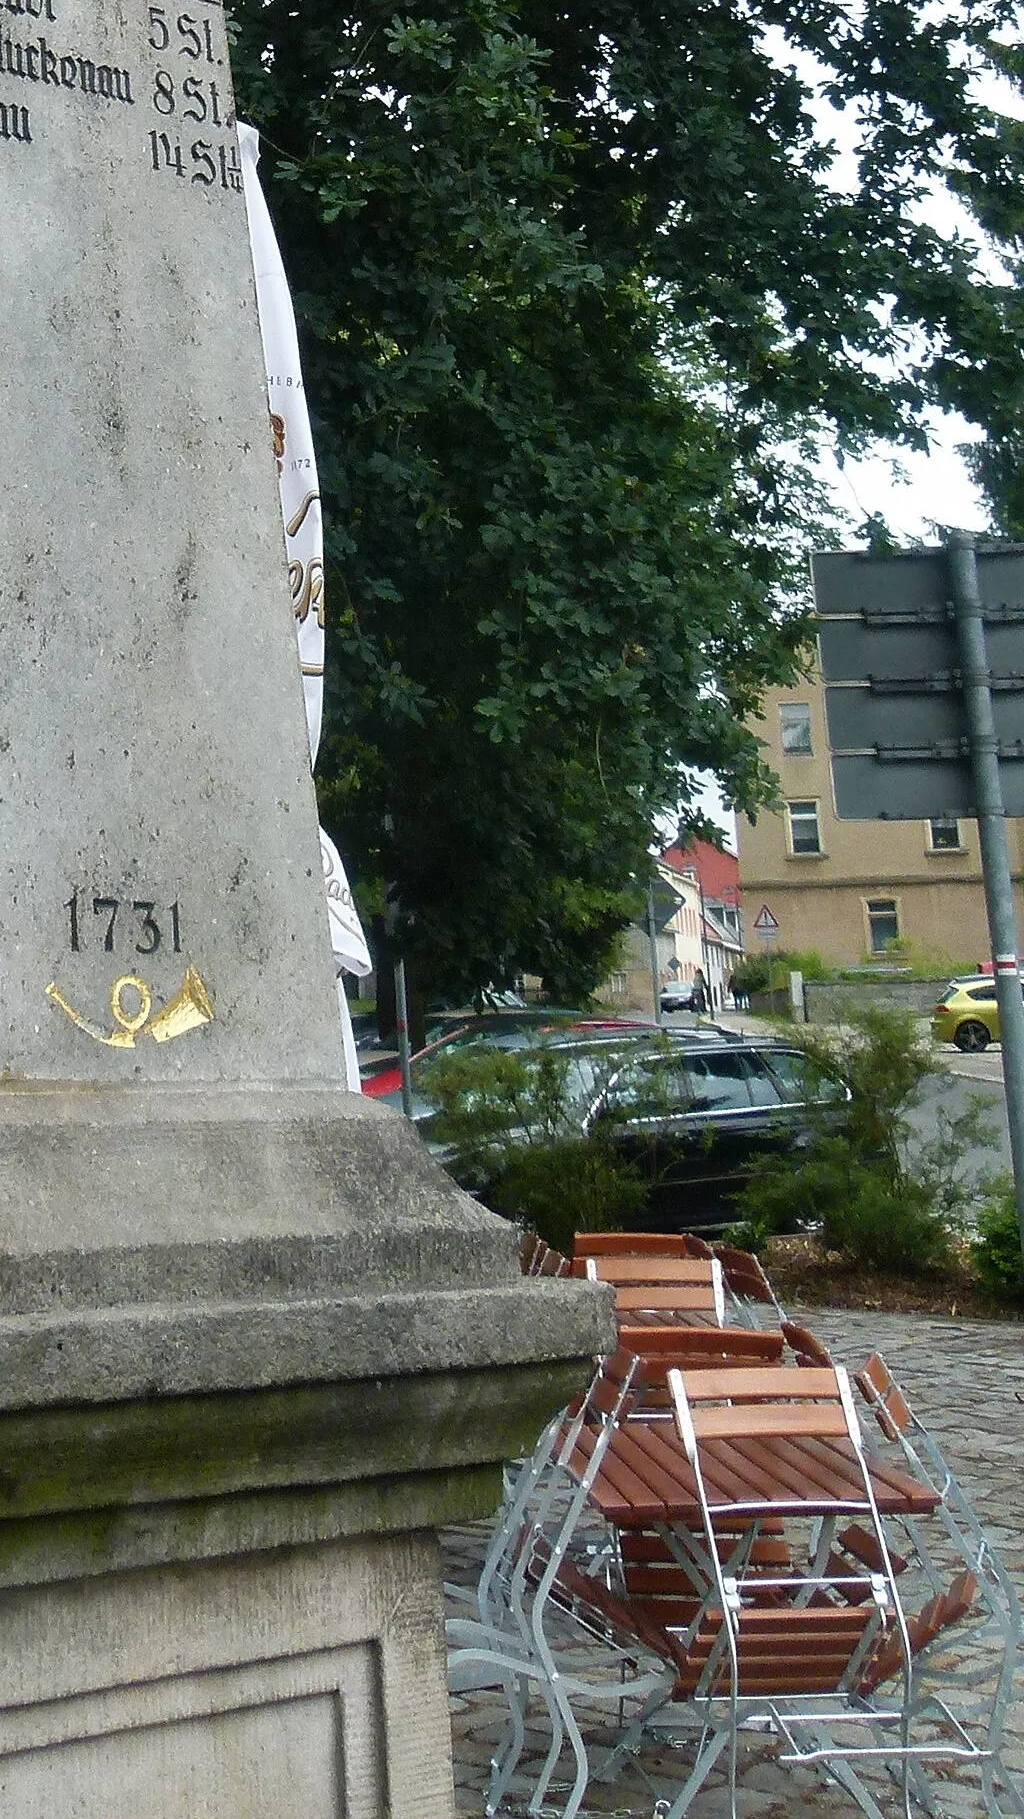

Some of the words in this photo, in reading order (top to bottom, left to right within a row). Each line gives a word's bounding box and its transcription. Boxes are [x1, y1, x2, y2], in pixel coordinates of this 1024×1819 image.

[148, 7, 169, 51] 5
[177, 14, 223, 65] St.
[153, 70, 175, 116] 8
[148, 130, 187, 178] 14
[62, 894, 182, 955] 1731
